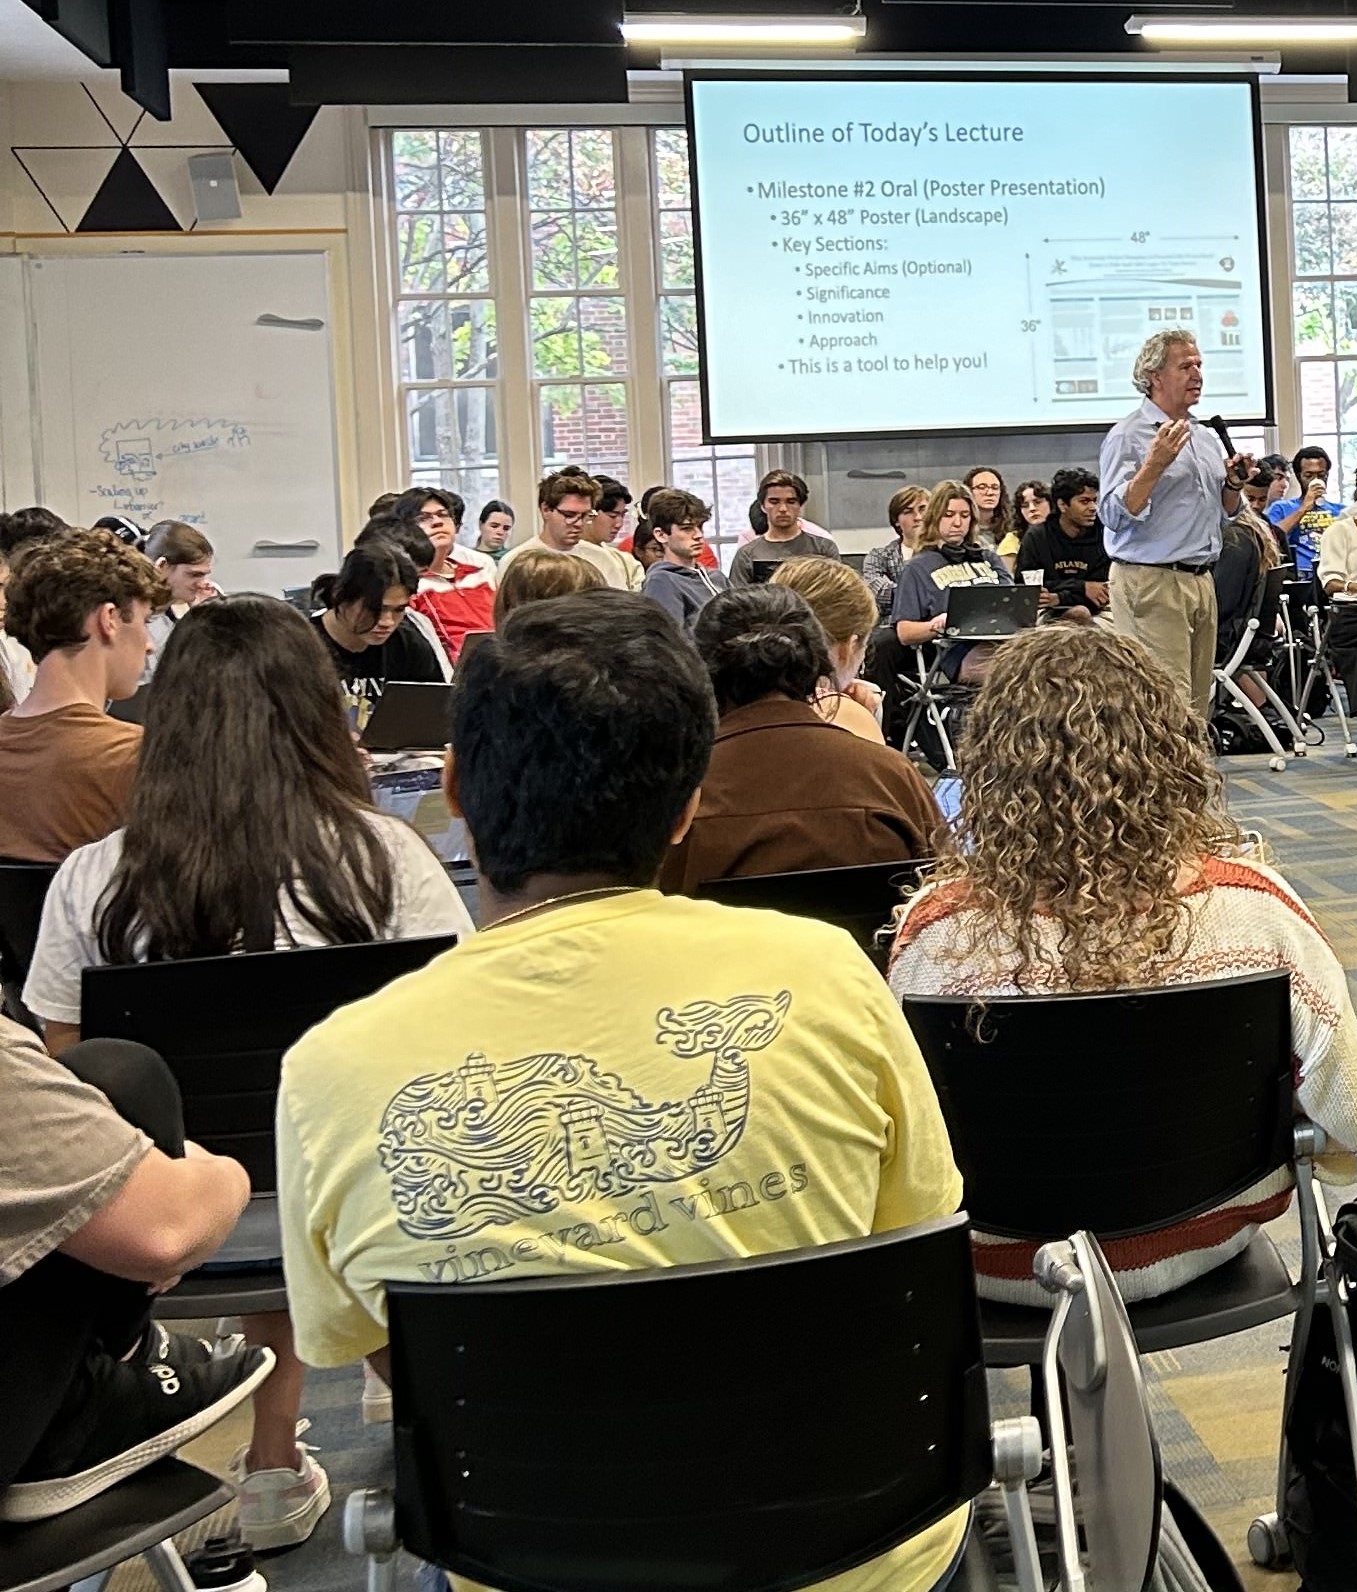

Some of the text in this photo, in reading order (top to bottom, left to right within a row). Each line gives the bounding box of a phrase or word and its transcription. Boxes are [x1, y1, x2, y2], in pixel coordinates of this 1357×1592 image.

[742, 121, 1025, 147] Outline of Today's Lecture
[757, 176, 1106, 201] Milestone #2 Oral (Poster Presentation)
[813, 215, 824, 226] x
[860, 208, 911, 226] Poster
[914, 206, 1009, 227] (Landscape)
[782, 235, 889, 255] Key Sections:
[804, 258, 973, 279] Specific Aims (Optional)
[806, 285, 891, 304] Significance
[807, 308, 884, 325] Innovation
[809, 331, 878, 351] Approach
[787, 351, 988, 375] This is a tool to help you!
[418, 1161, 810, 1284] vineyard vines
